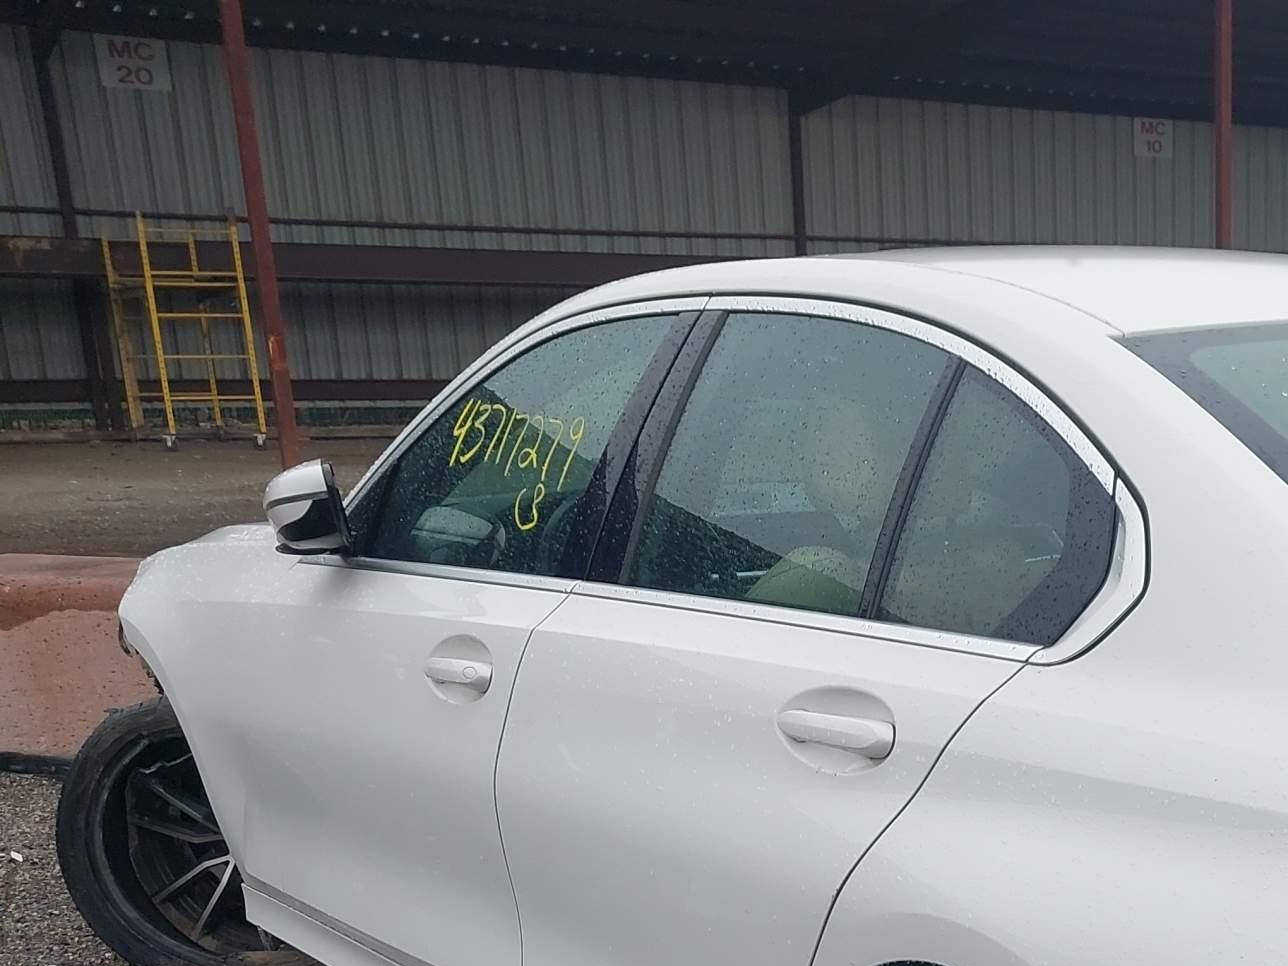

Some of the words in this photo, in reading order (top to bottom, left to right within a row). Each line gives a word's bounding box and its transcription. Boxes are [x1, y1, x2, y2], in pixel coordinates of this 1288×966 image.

[106, 40, 154, 60] MC
[117, 65, 153, 85] 20
[1141, 121, 1166, 136] MC
[1146, 140, 1162, 153] 10
